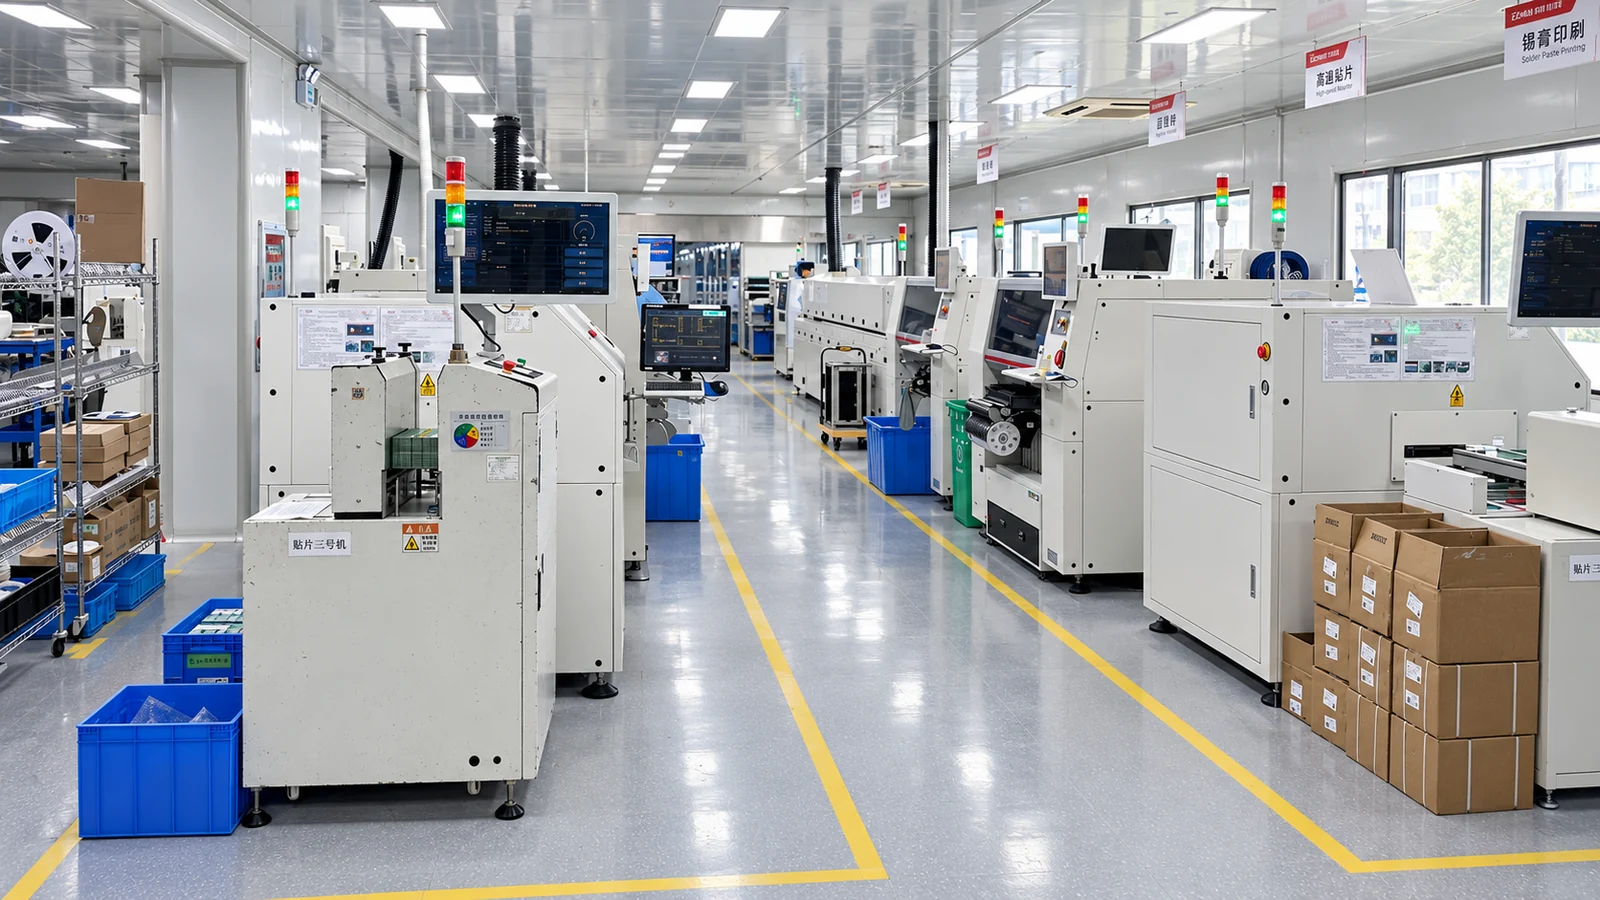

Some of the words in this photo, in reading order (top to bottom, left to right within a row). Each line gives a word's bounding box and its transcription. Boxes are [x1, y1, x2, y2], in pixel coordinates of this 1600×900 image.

[1522, 19, 1585, 52] 锡膏印刷
[1521, 53, 1541, 64] Solder
[1542, 49, 1560, 59] Paste
[1561, 43, 1586, 55] Printing
[292, 538, 347, 550] 贴片三号机
[1573, 563, 1600, 575] 贴片三
